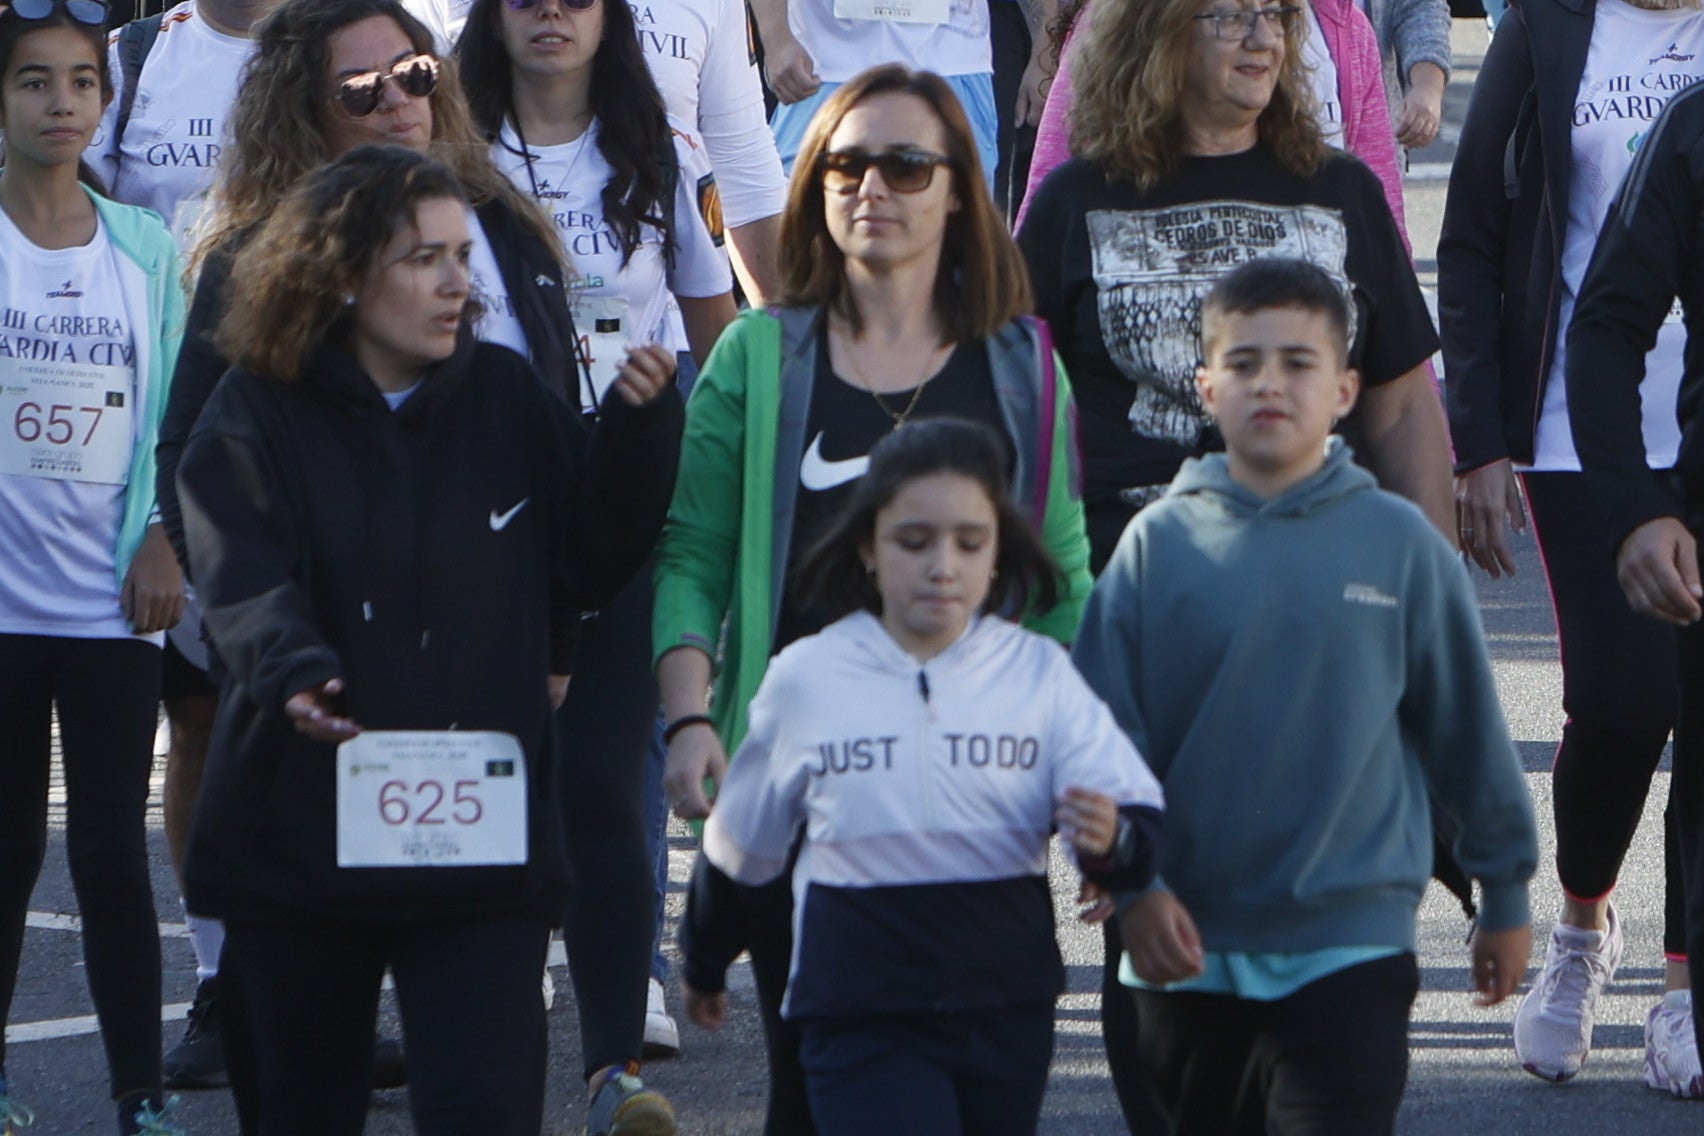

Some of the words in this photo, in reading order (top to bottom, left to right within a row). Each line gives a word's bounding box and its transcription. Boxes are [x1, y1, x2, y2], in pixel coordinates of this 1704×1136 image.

[1608, 75, 1632, 92] III
[187, 118, 213, 137] III
[1222, 220, 1243, 237] DE
[1248, 223, 1286, 240] DIOS
[4, 308, 26, 330] III
[34, 314, 122, 339] CARRERA
[14, 401, 103, 446] 657
[811, 736, 898, 778] JUST
[377, 779, 485, 826] 625
